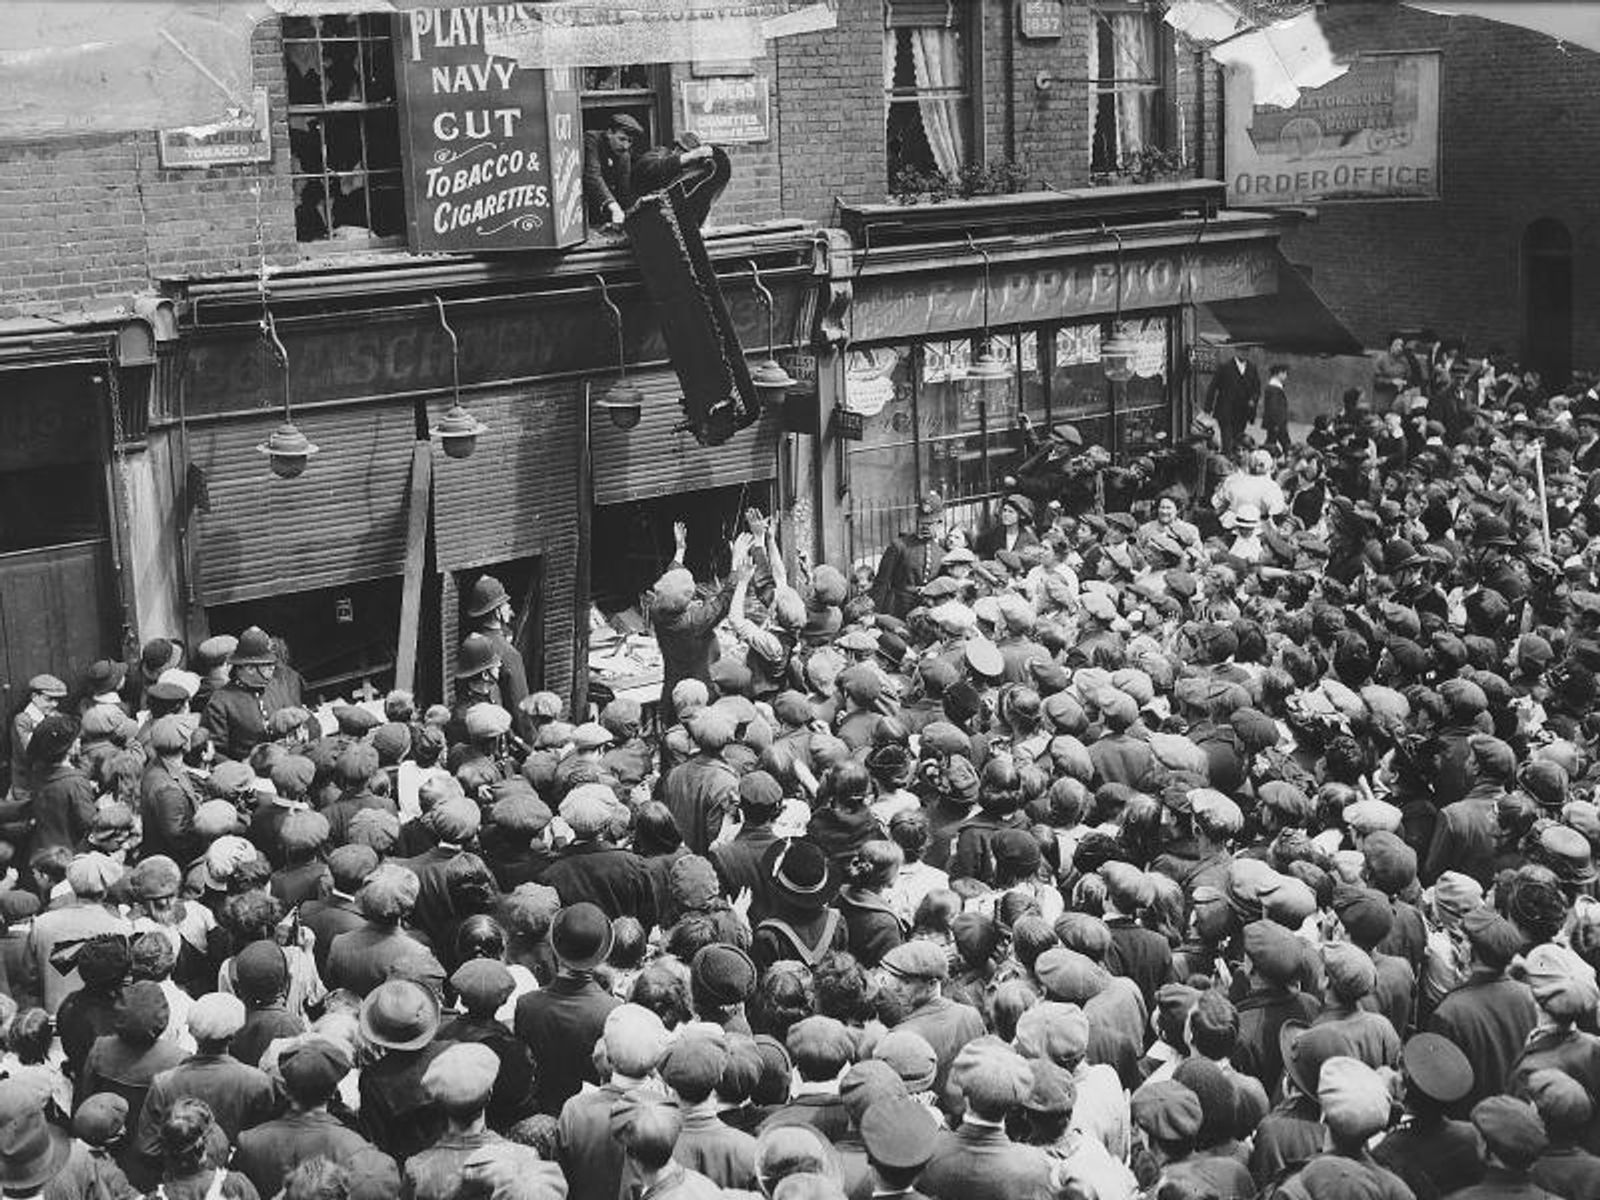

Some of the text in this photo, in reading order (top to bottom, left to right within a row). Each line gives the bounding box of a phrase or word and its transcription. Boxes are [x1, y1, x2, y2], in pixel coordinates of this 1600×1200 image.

[431, 56, 520, 94] NAVY
[433, 108, 522, 141] CUT
[425, 150, 523, 199] TOBACCO
[527, 151, 541, 172] &
[1235, 164, 1430, 196] ORDER OFFICE
